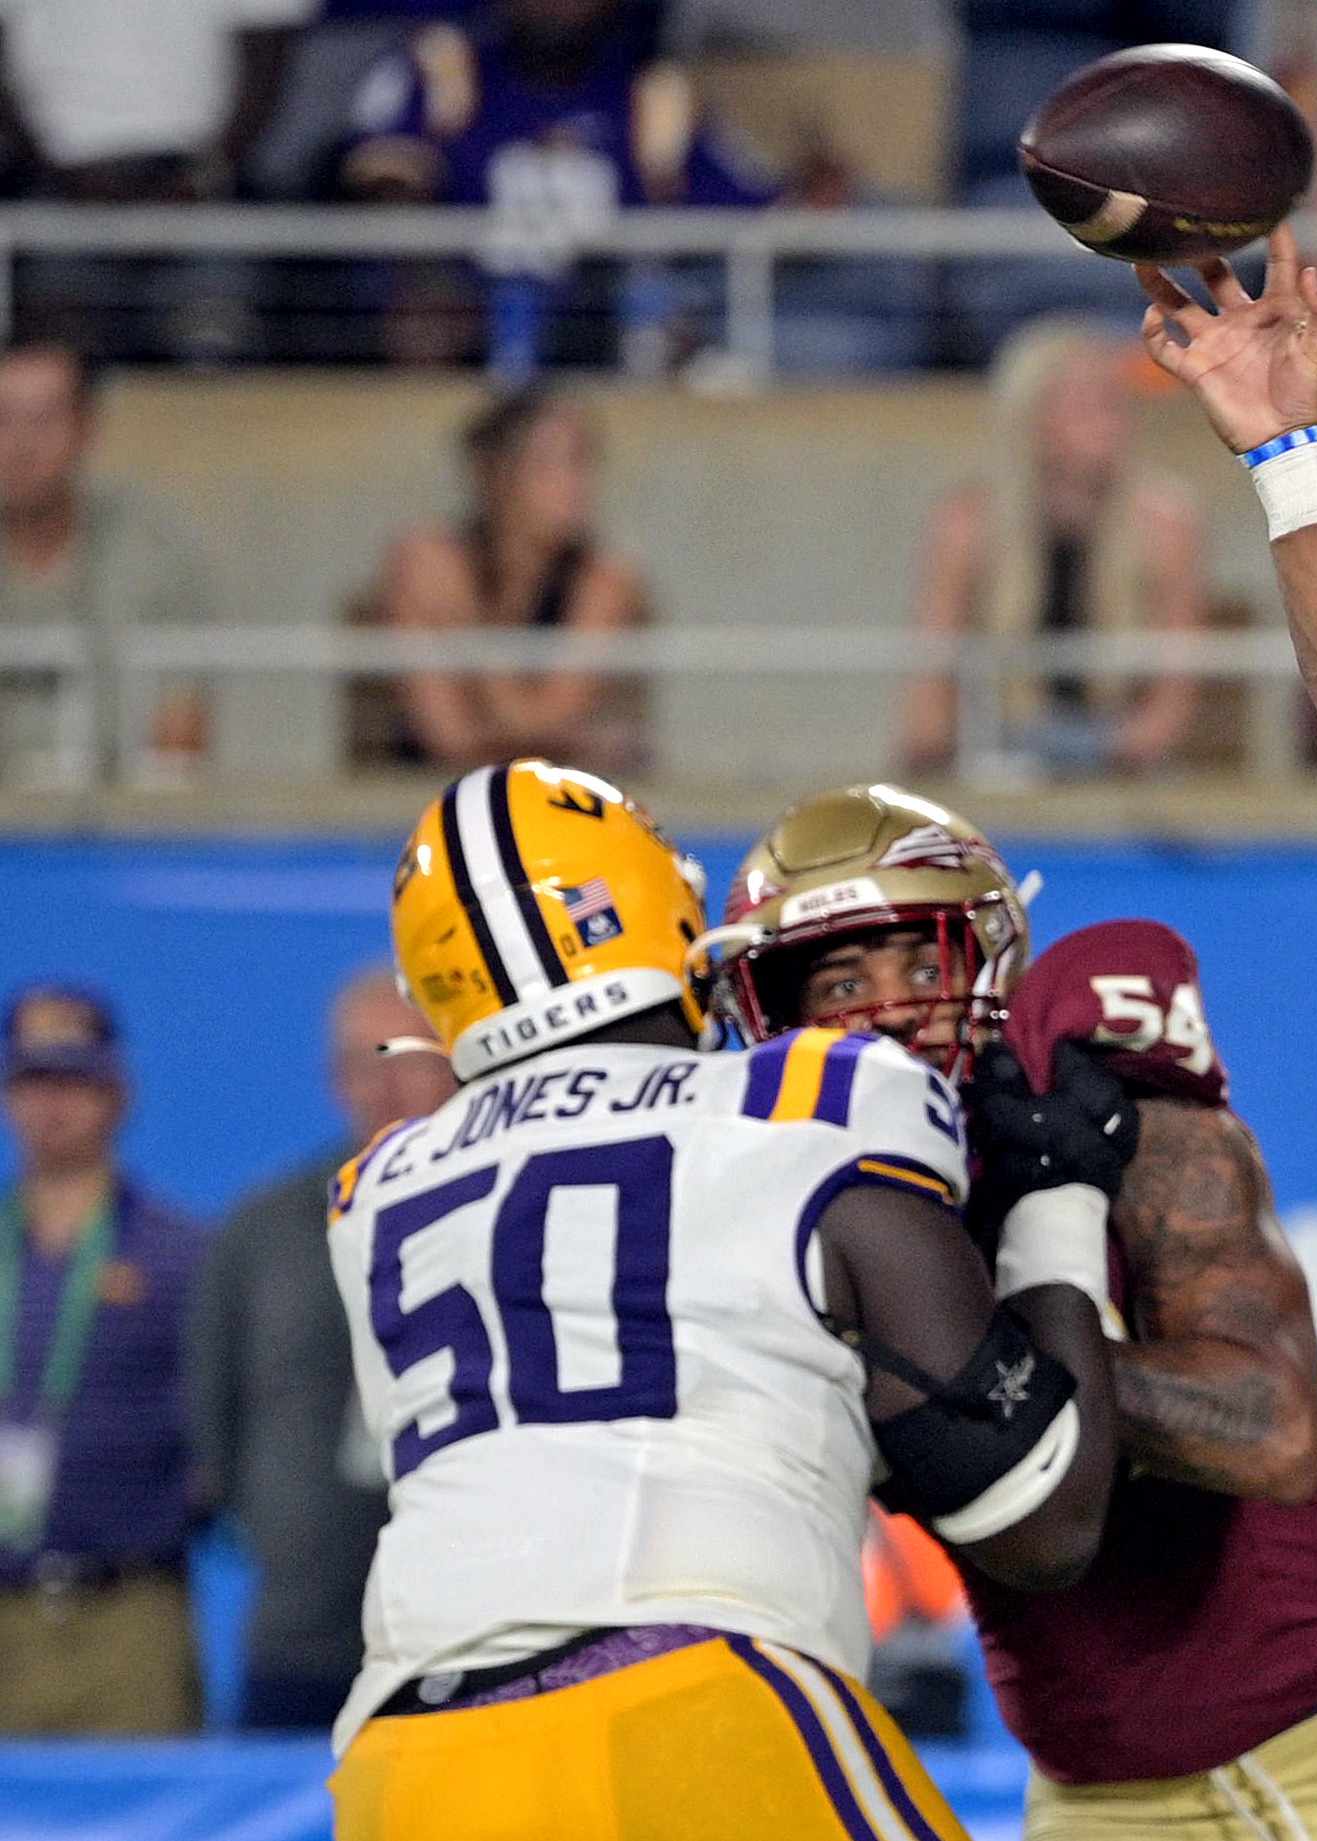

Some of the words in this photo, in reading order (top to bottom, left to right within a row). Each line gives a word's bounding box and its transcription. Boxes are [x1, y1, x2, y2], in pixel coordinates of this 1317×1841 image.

[477, 982, 629, 1057] TIGERS
[1089, 975, 1214, 1076] 54
[377, 1127, 429, 1184] E.
[430, 1069, 607, 1162] JONES
[610, 1061, 700, 1113] JR.
[369, 1134, 679, 1481] 50
